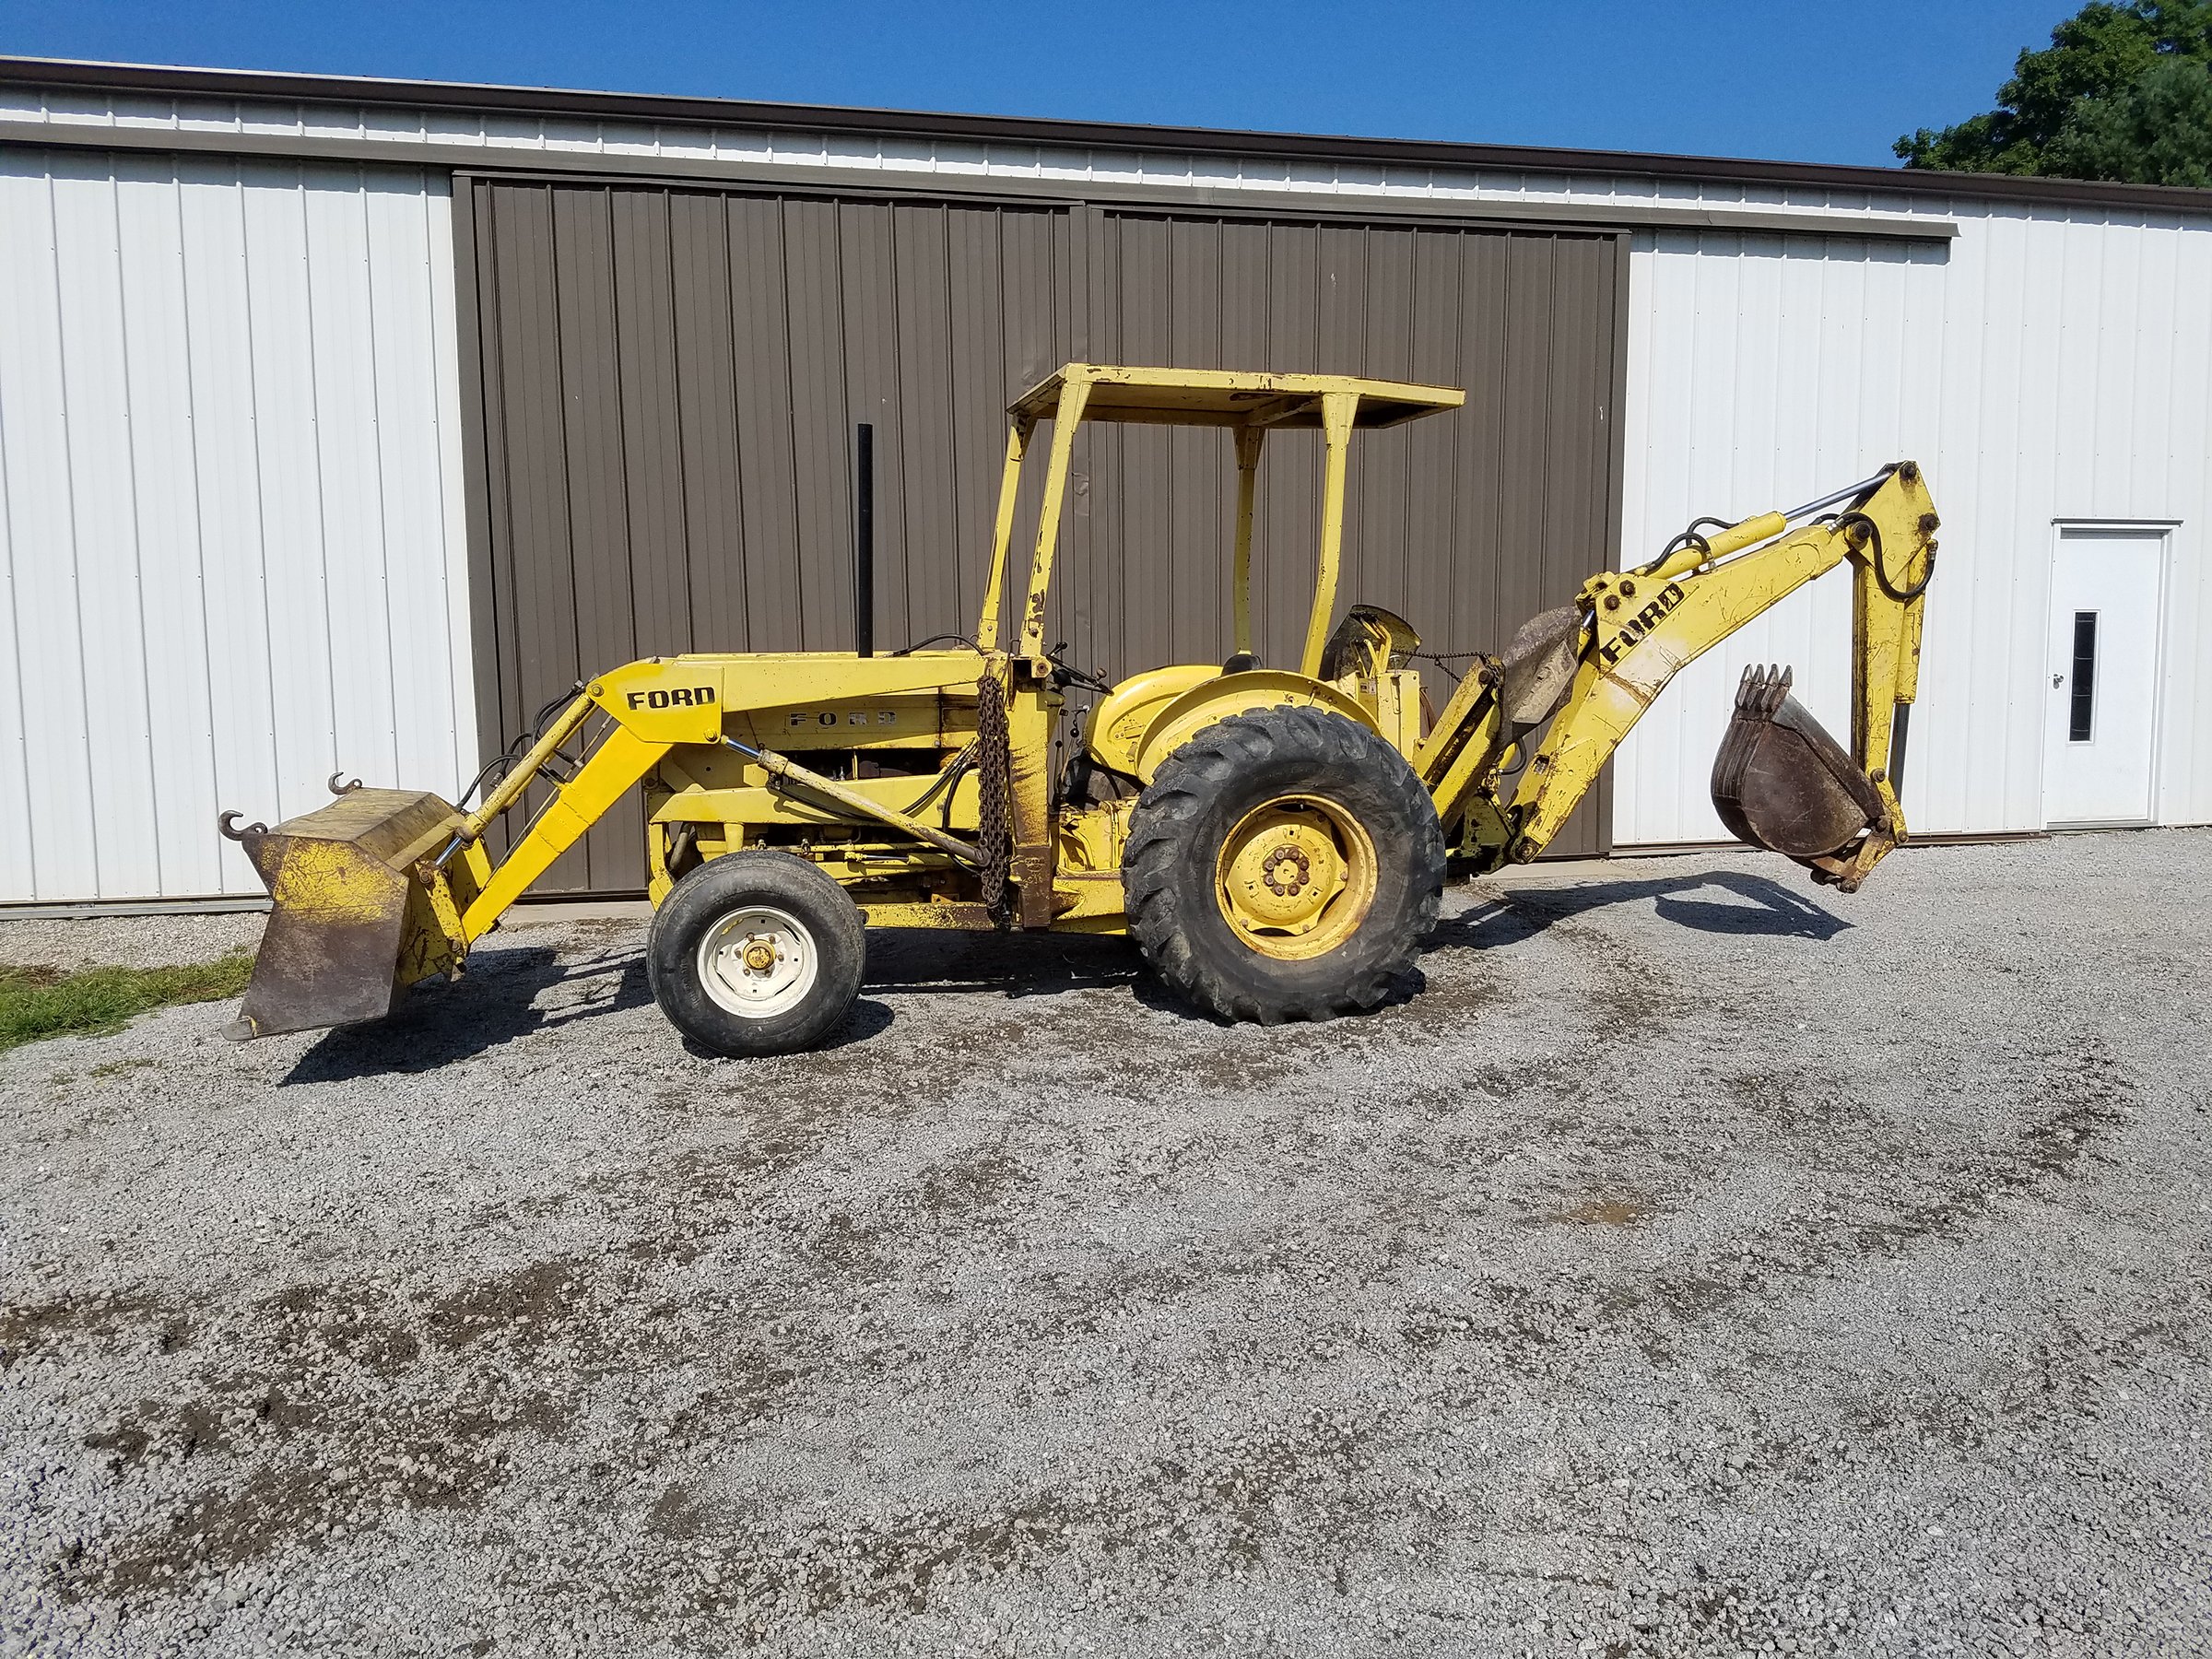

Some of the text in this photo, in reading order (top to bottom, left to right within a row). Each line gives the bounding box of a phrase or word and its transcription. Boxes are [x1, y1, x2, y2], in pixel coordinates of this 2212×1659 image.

[1600, 582, 1685, 665] FORD
[627, 687, 715, 711] FORD
[790, 711, 897, 726] FORD
